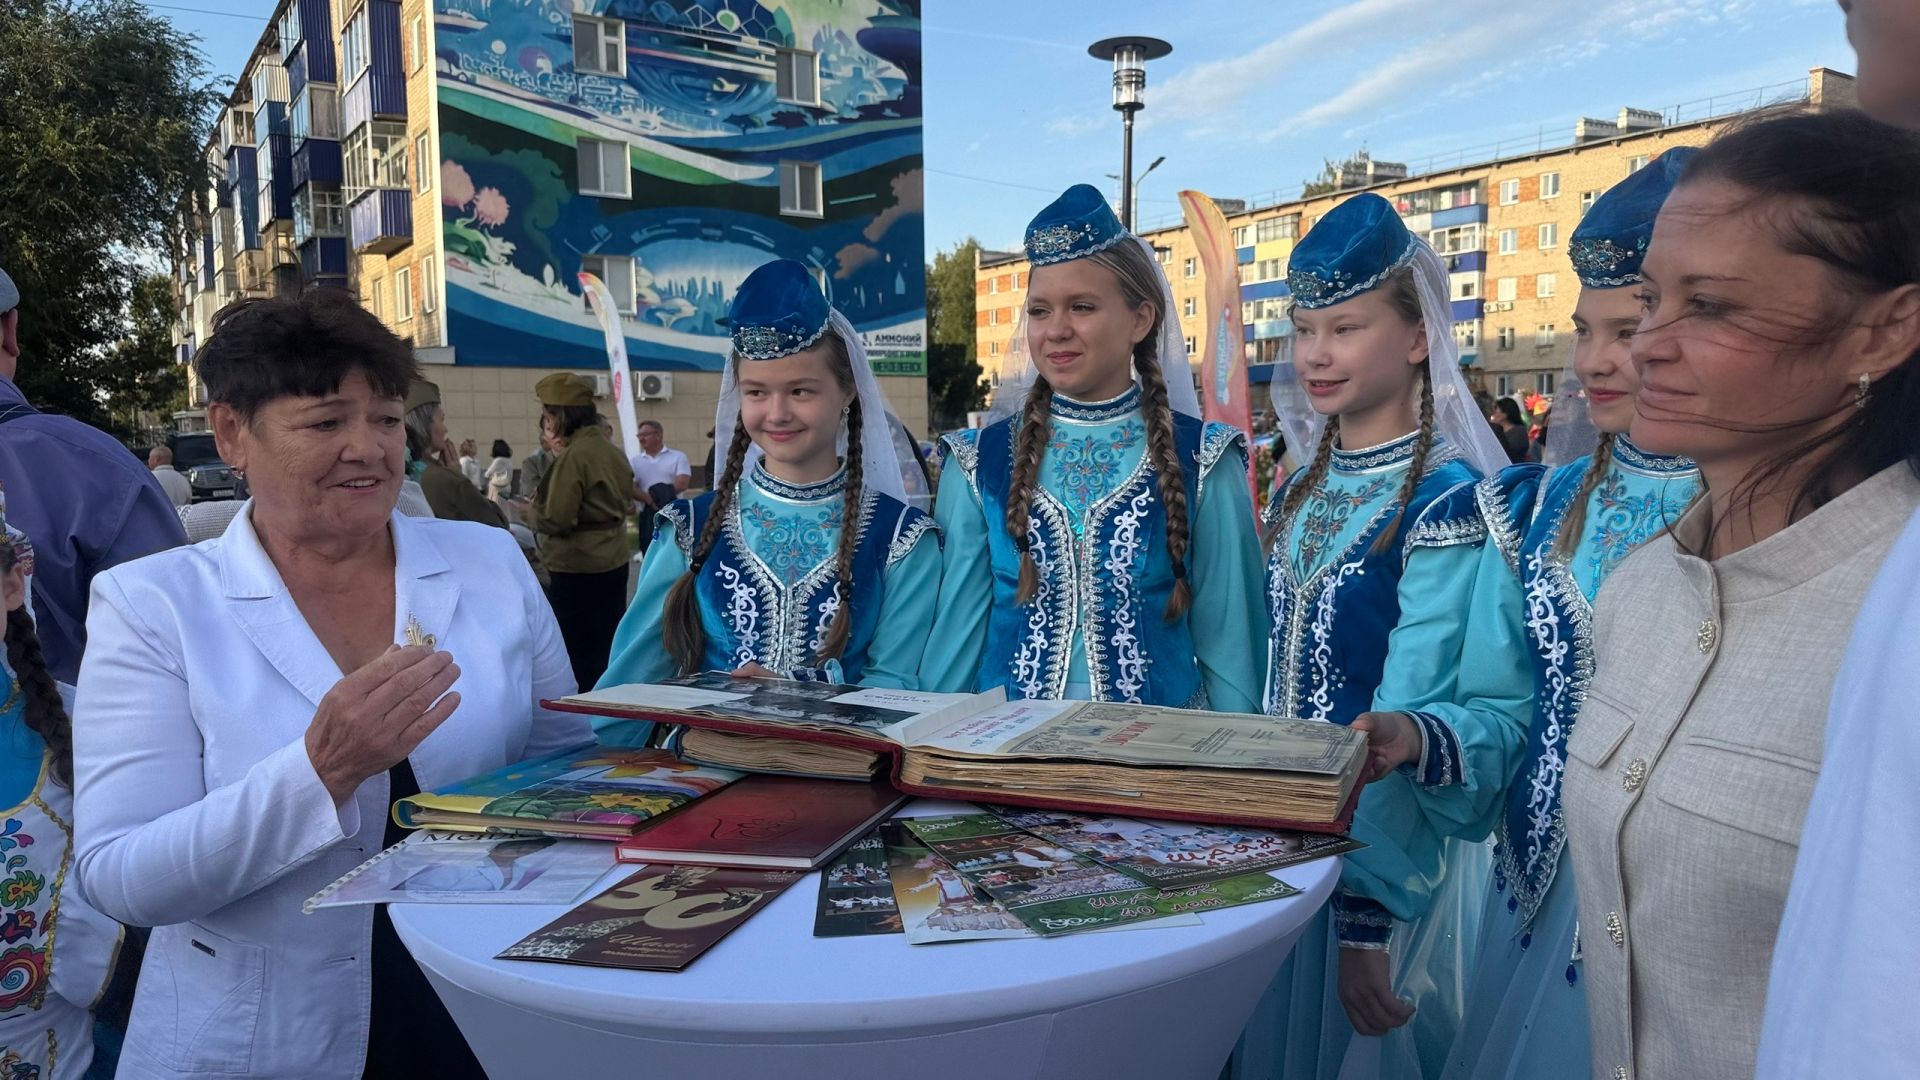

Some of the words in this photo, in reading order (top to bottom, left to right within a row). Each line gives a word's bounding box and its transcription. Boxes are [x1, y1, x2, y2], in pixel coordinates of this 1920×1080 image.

[874, 333, 922, 343] АММОНИЙ
[1206, 857, 1234, 867] 45
[1019, 890, 1080, 905] НАРОДНЫЙ
[1121, 905, 1155, 917] 40
[1171, 897, 1226, 912] лет
